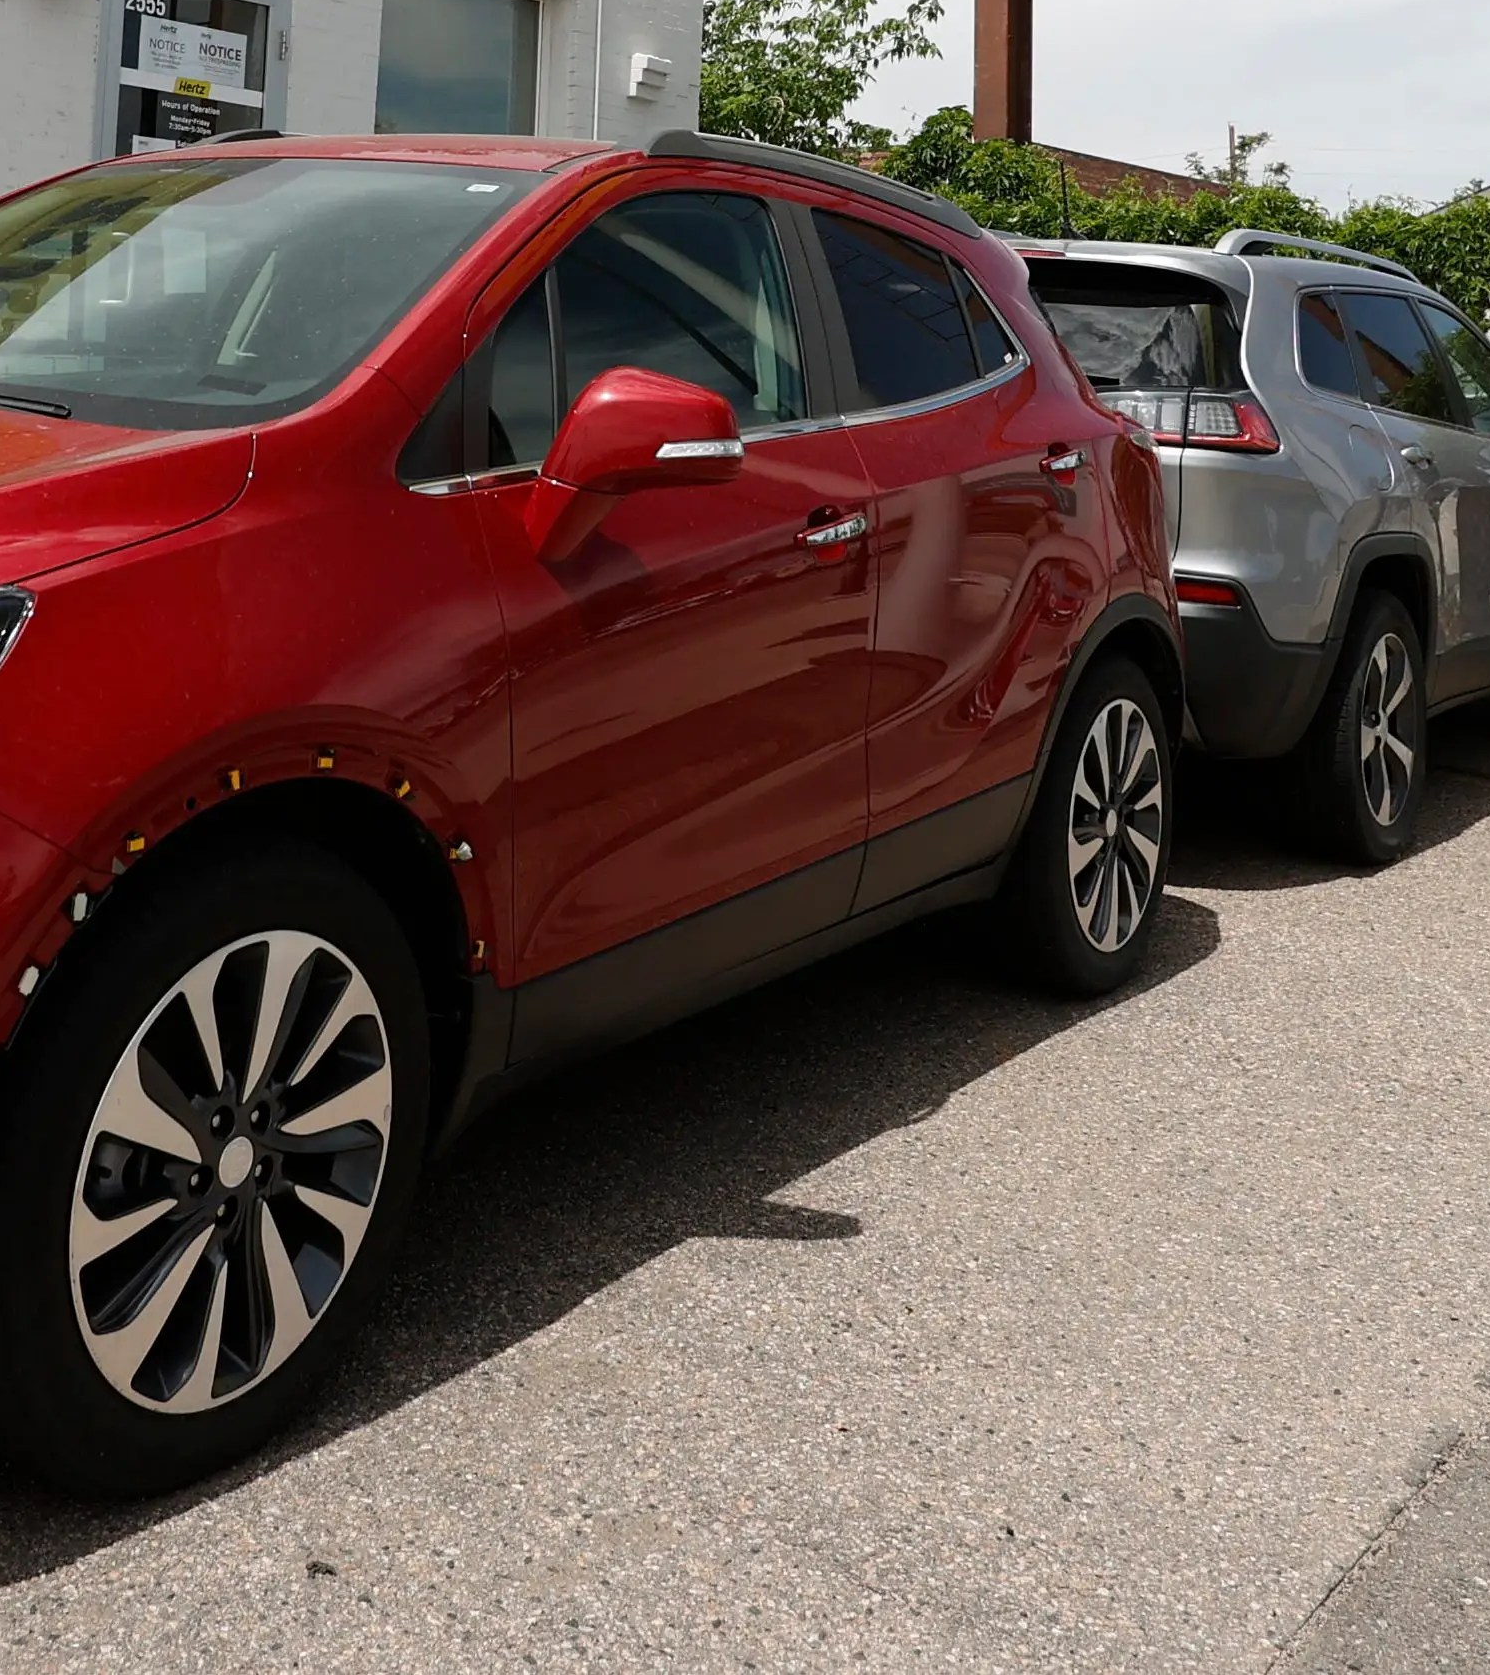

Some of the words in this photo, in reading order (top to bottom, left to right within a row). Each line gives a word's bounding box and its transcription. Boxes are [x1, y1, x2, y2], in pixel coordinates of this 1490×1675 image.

[149, 37, 186, 54] NOTICE
[198, 42, 242, 62] NOTICE
[178, 80, 206, 95] Hertz
[161, 99, 181, 110] Hours
